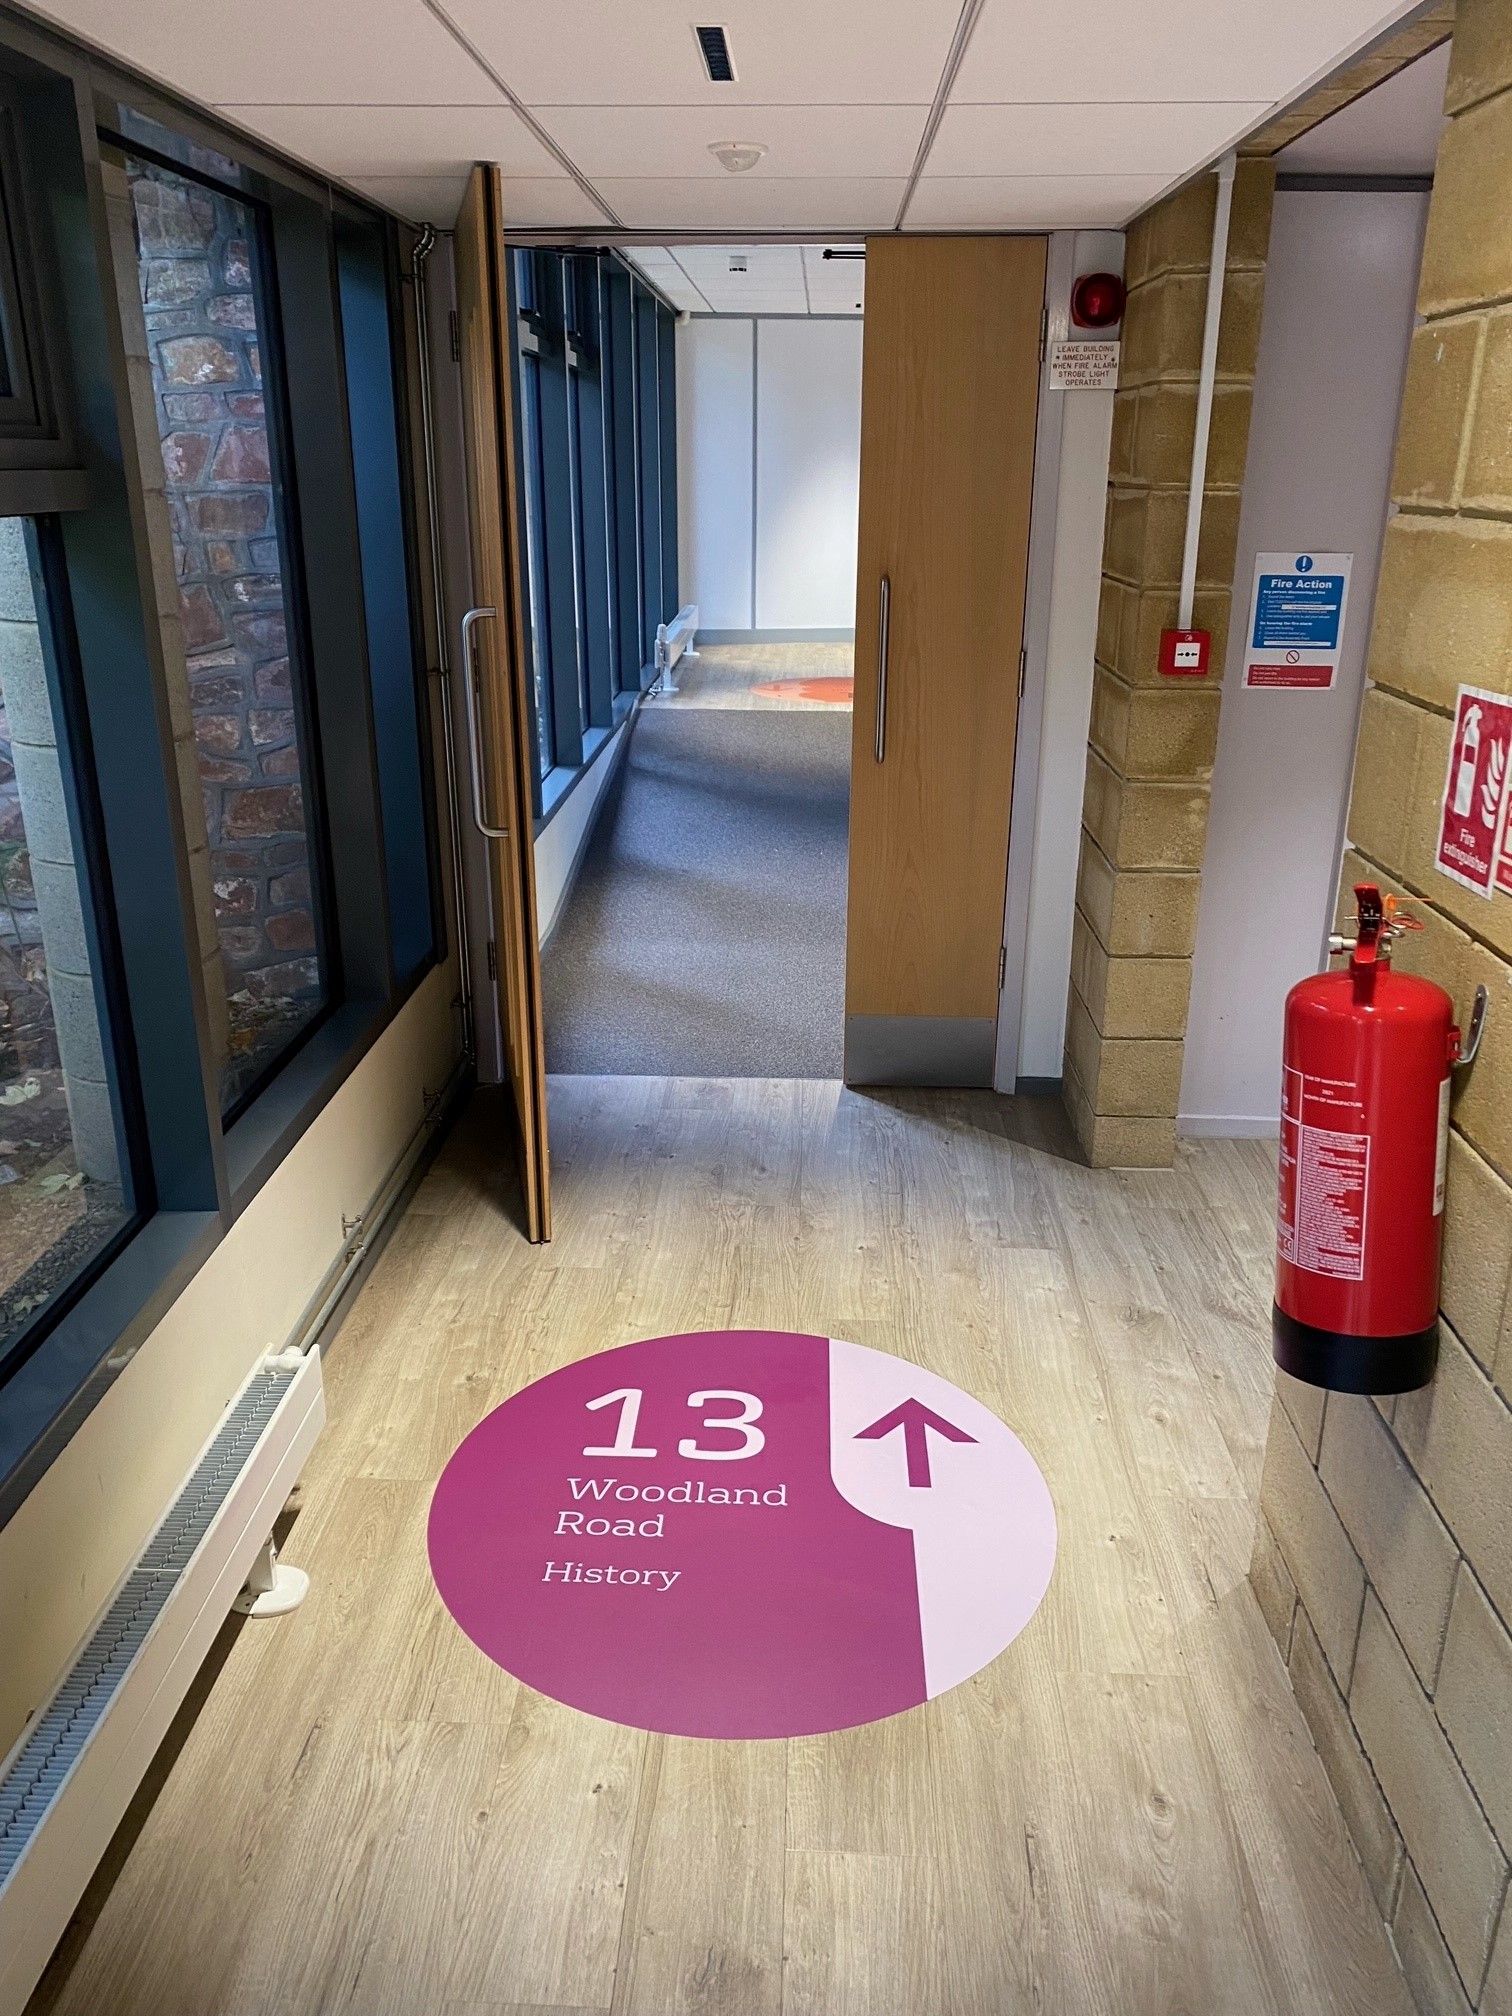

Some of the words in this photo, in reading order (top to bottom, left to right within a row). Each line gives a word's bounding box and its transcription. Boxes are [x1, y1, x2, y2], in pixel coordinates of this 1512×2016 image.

[1057, 345, 1080, 353] LEAVE
[1083, 345, 1114, 353] BUILDING
[1062, 353, 1108, 361] IMMEDIATELY
[1052, 362, 1072, 370] WHEN
[1074, 362, 1089, 370] FIRE
[1093, 361, 1118, 369] ALARM
[1058, 370, 1086, 378] STROBE
[1089, 370, 1110, 378] LIGHT
[1270, 578, 1293, 588] Fire
[1295, 579, 1333, 589] Action
[1460, 828, 1476, 848] Fire
[1443, 841, 1488, 875] extinguisher
[582, 1388, 766, 1461] 13
[566, 1477, 788, 1507] Woodland
[553, 1510, 665, 1538] Road
[541, 1560, 682, 1592] History
